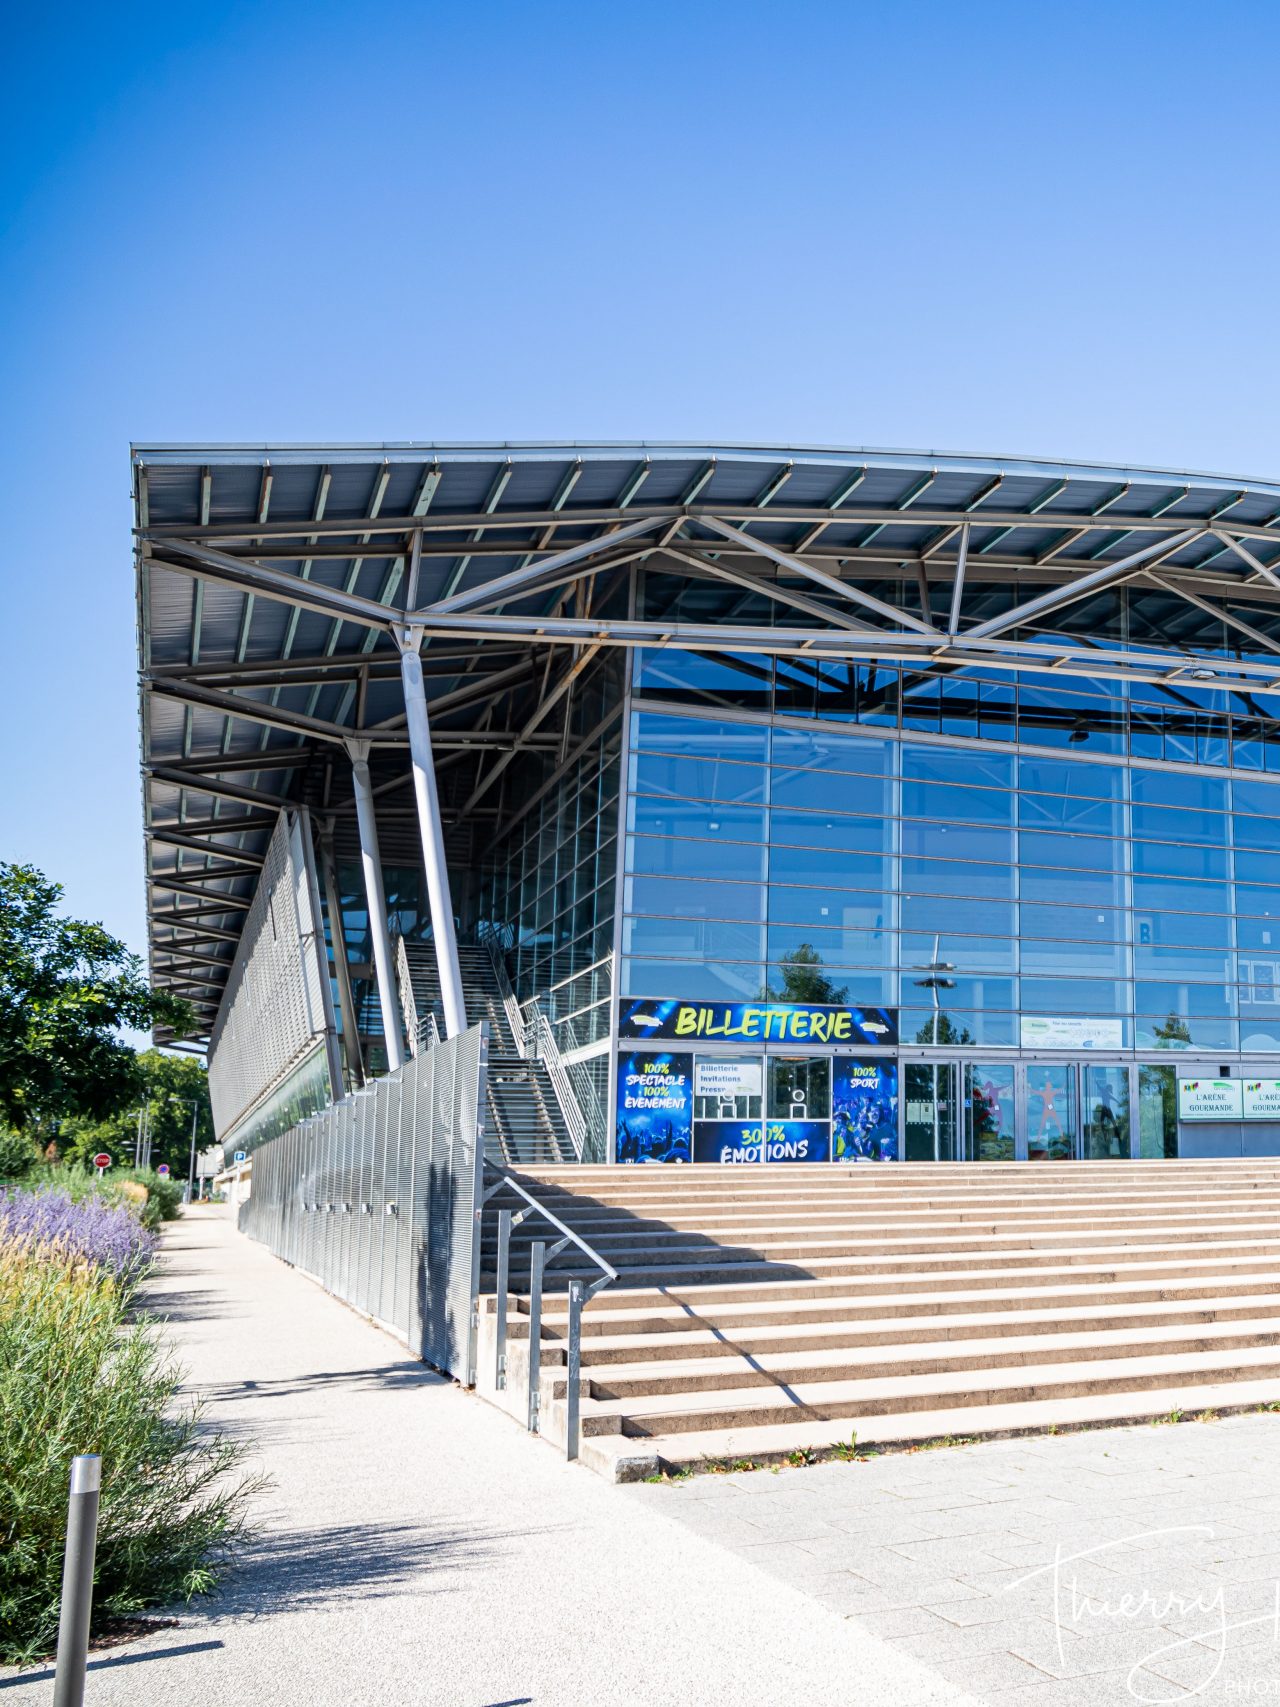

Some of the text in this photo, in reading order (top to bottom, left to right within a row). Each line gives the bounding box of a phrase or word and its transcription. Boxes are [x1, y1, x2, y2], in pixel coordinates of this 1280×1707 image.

[675, 1006, 853, 1042] BILLETTERIE
[643, 1063, 670, 1074] 100%
[700, 1064, 739, 1072] Billetterie
[853, 1066, 877, 1077] 100%
[625, 1075, 686, 1086] SPECTACLE
[850, 1078, 880, 1090] SPORT
[643, 1087, 669, 1097] 100%
[720, 1139, 809, 1164] ÉMOTIONS
